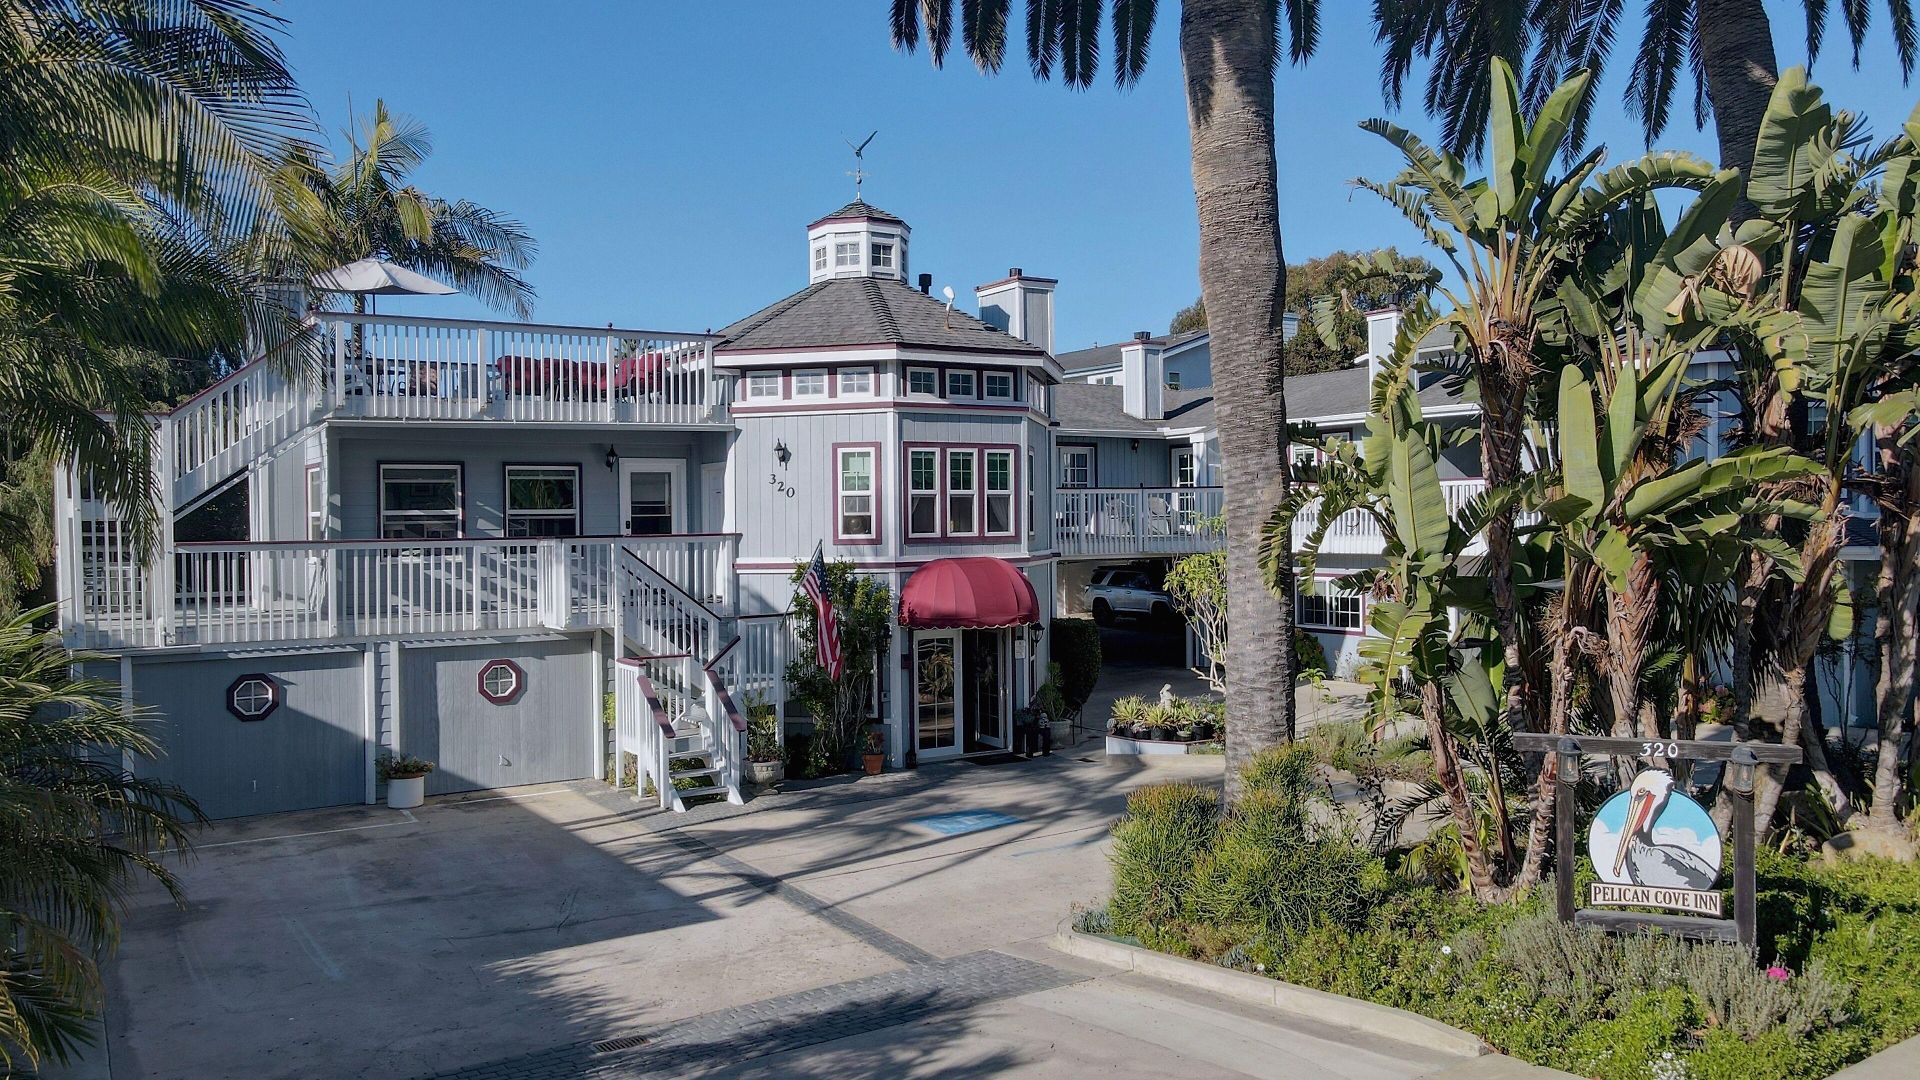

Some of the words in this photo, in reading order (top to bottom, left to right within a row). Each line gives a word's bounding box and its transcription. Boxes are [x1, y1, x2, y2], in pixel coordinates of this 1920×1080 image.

[768, 473, 795, 498] 320
[1639, 742, 1678, 758] 320
[1593, 885, 1650, 903] PELICAN
[1654, 890, 1690, 907] COVE
[1694, 894, 1718, 912] INN
